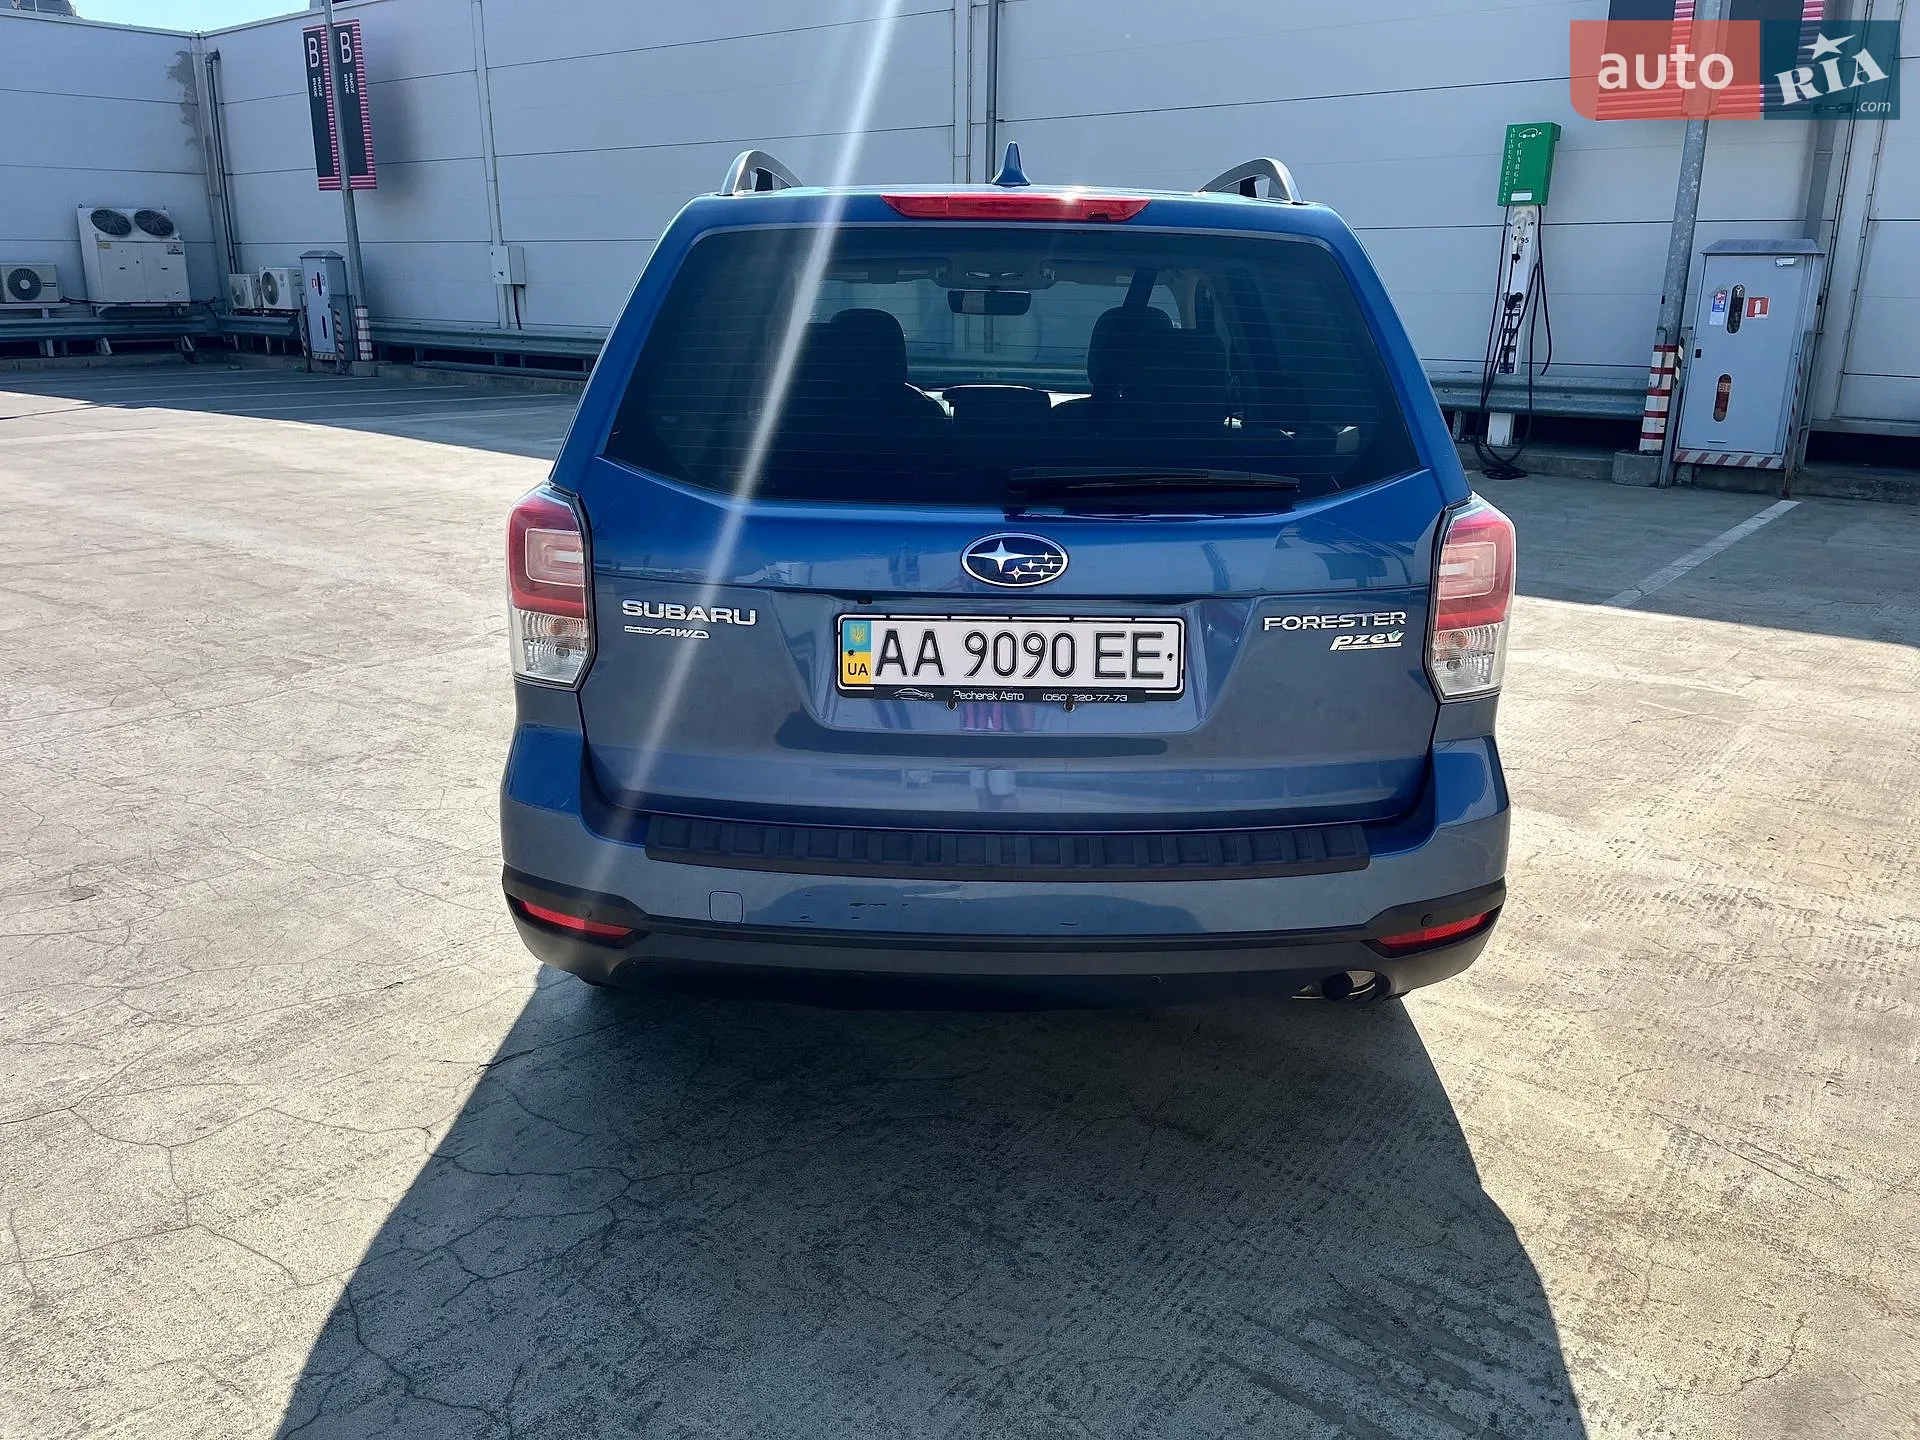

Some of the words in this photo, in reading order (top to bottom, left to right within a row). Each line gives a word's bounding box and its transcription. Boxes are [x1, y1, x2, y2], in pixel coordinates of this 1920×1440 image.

[307, 37, 319, 68] B
[340, 32, 352, 63] B
[622, 599, 757, 626] SUBARU
[1263, 611, 1407, 631] FORESTER
[655, 627, 710, 639] AWD
[875, 629, 945, 677] AA
[964, 630, 1076, 678] 9090
[1094, 631, 1164, 679] EE
[847, 663, 868, 676] UA
[952, 690, 998, 701] Pechersk
[1072, 694, 1128, 702] 220-77-73
